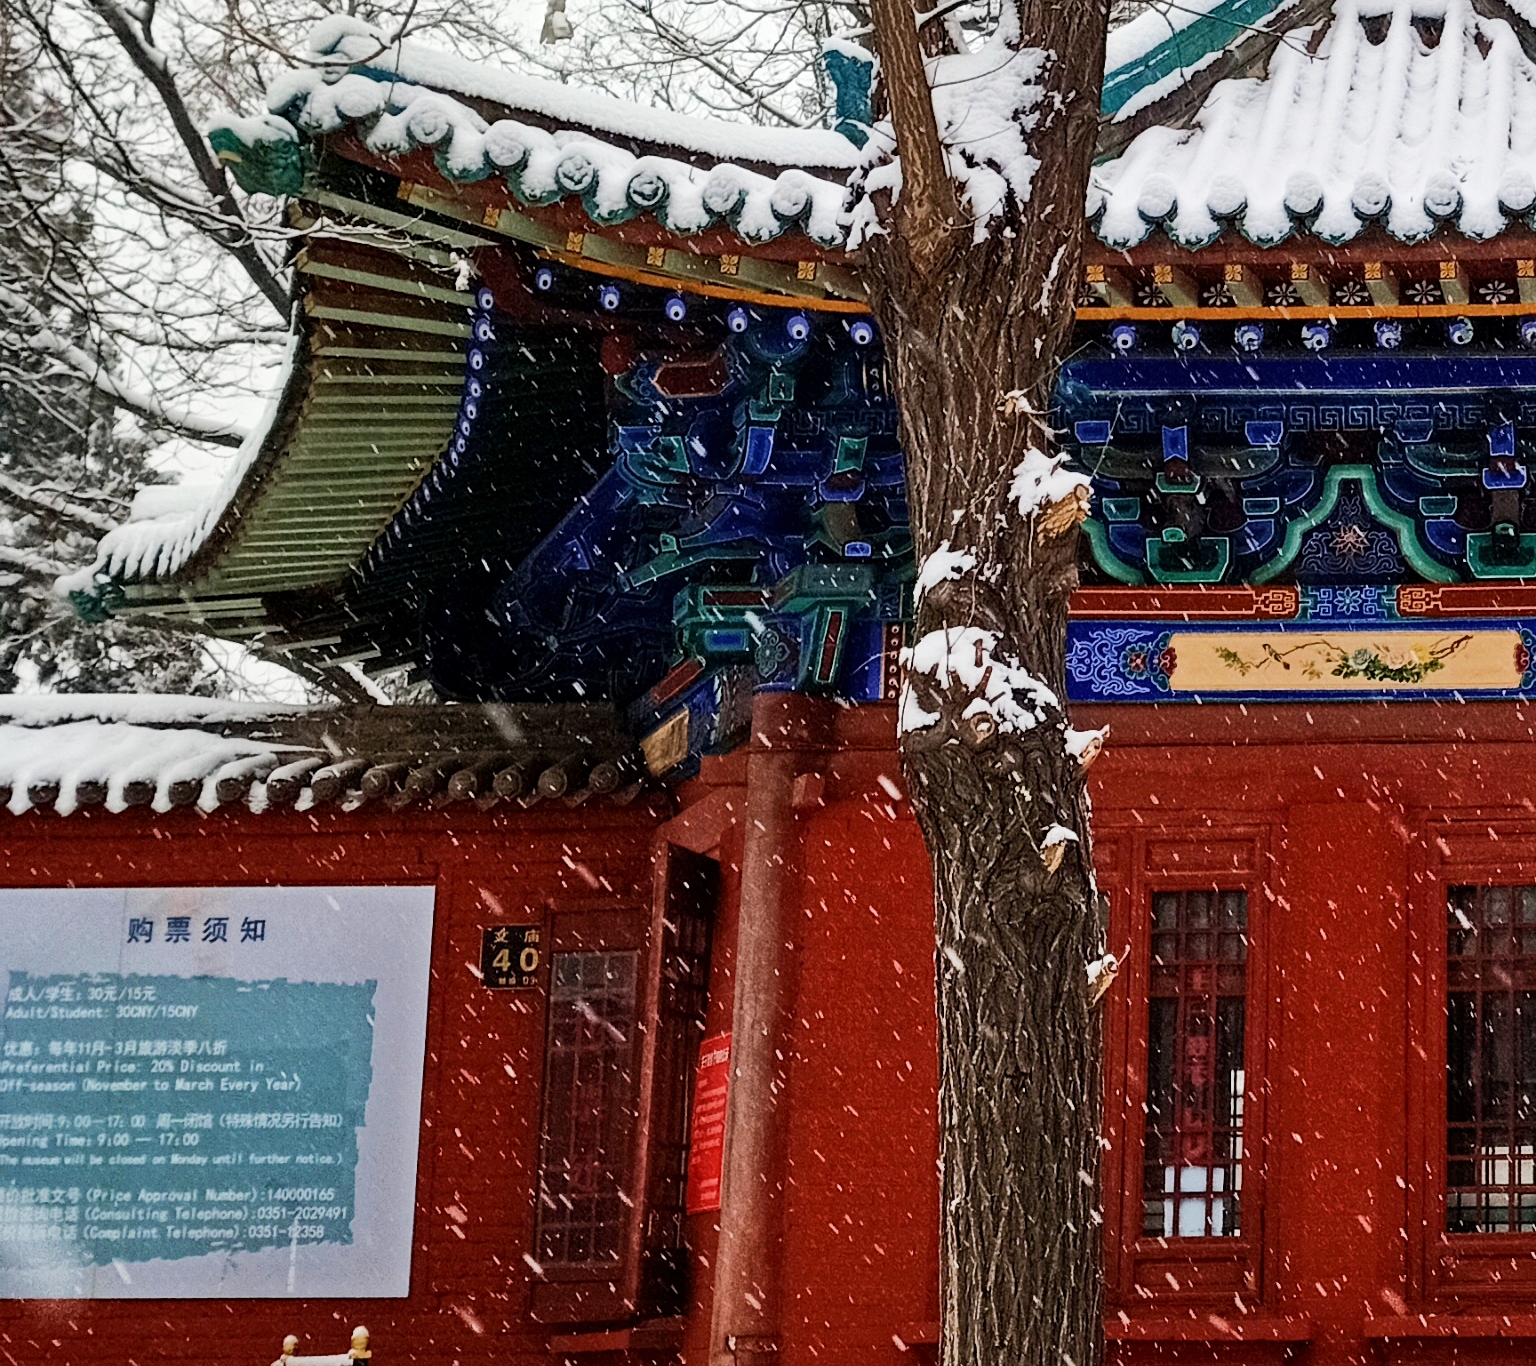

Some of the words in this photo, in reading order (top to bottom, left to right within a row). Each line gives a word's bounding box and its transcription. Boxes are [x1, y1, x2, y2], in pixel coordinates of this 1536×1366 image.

[127, 917, 266, 943] 购票须知
[0, 1060, 90, 1074] Preferential
[150, 1059, 174, 1073] 20%
[180, 1059, 241, 1073] Discount
[250, 1060, 264, 1073] in
[154, 1080, 169, 1091] to
[175, 1079, 214, 1092] March
[220, 1078, 259, 1093] Every
[97, 1133, 130, 1147] 9:00
[159, 1133, 200, 1146] 17:00
[64, 1154, 85, 1165] will
[90, 1154, 103, 1165] be
[109, 1154, 147, 1165] closed
[152, 1156, 166, 1165] on
[170, 1153, 209, 1167] Monday
[212, 1152, 243, 1165] until
[249, 1152, 291, 1165] further
[138, 1188, 198, 1204] Approval
